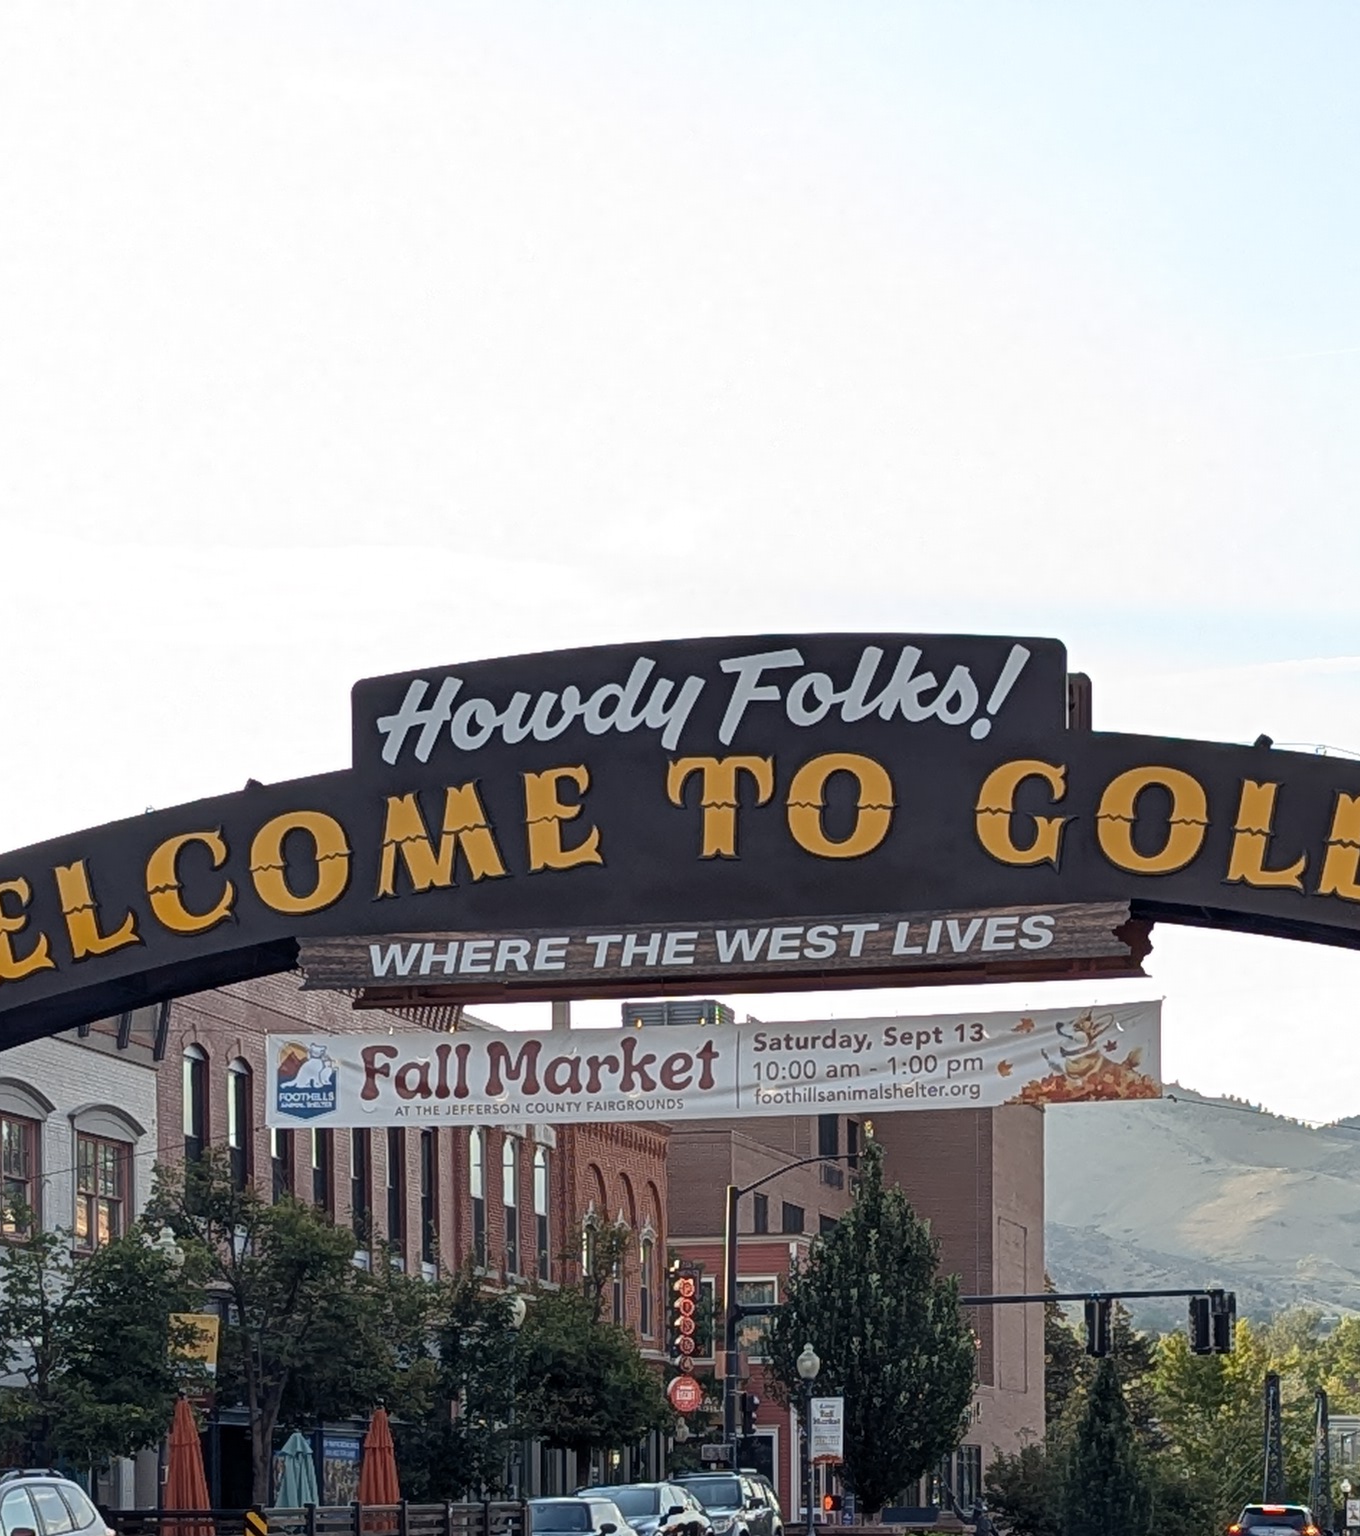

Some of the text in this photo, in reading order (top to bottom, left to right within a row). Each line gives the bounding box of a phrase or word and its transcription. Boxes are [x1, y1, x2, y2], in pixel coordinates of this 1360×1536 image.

[376, 644, 1030, 765] Howdy Folks!
[665, 751, 896, 860] TO
[368, 914, 1056, 977] WHERE THE WEST LIVES
[753, 1023, 984, 1053] Saturday, Sept 13
[360, 1036, 720, 1100] Fall Market
[753, 1059, 817, 1081] 10:00
[825, 1062, 861, 1079] am
[887, 1054, 938, 1076] 1:00
[947, 1056, 984, 1078] pm
[279, 1091, 335, 1102] FOOTHILLS
[394, 1098, 685, 1117] AT THE JEFFERSON COUNTY FAIRGROUNDS
[754, 1080, 981, 1105] foothillsanimalshelter.org
